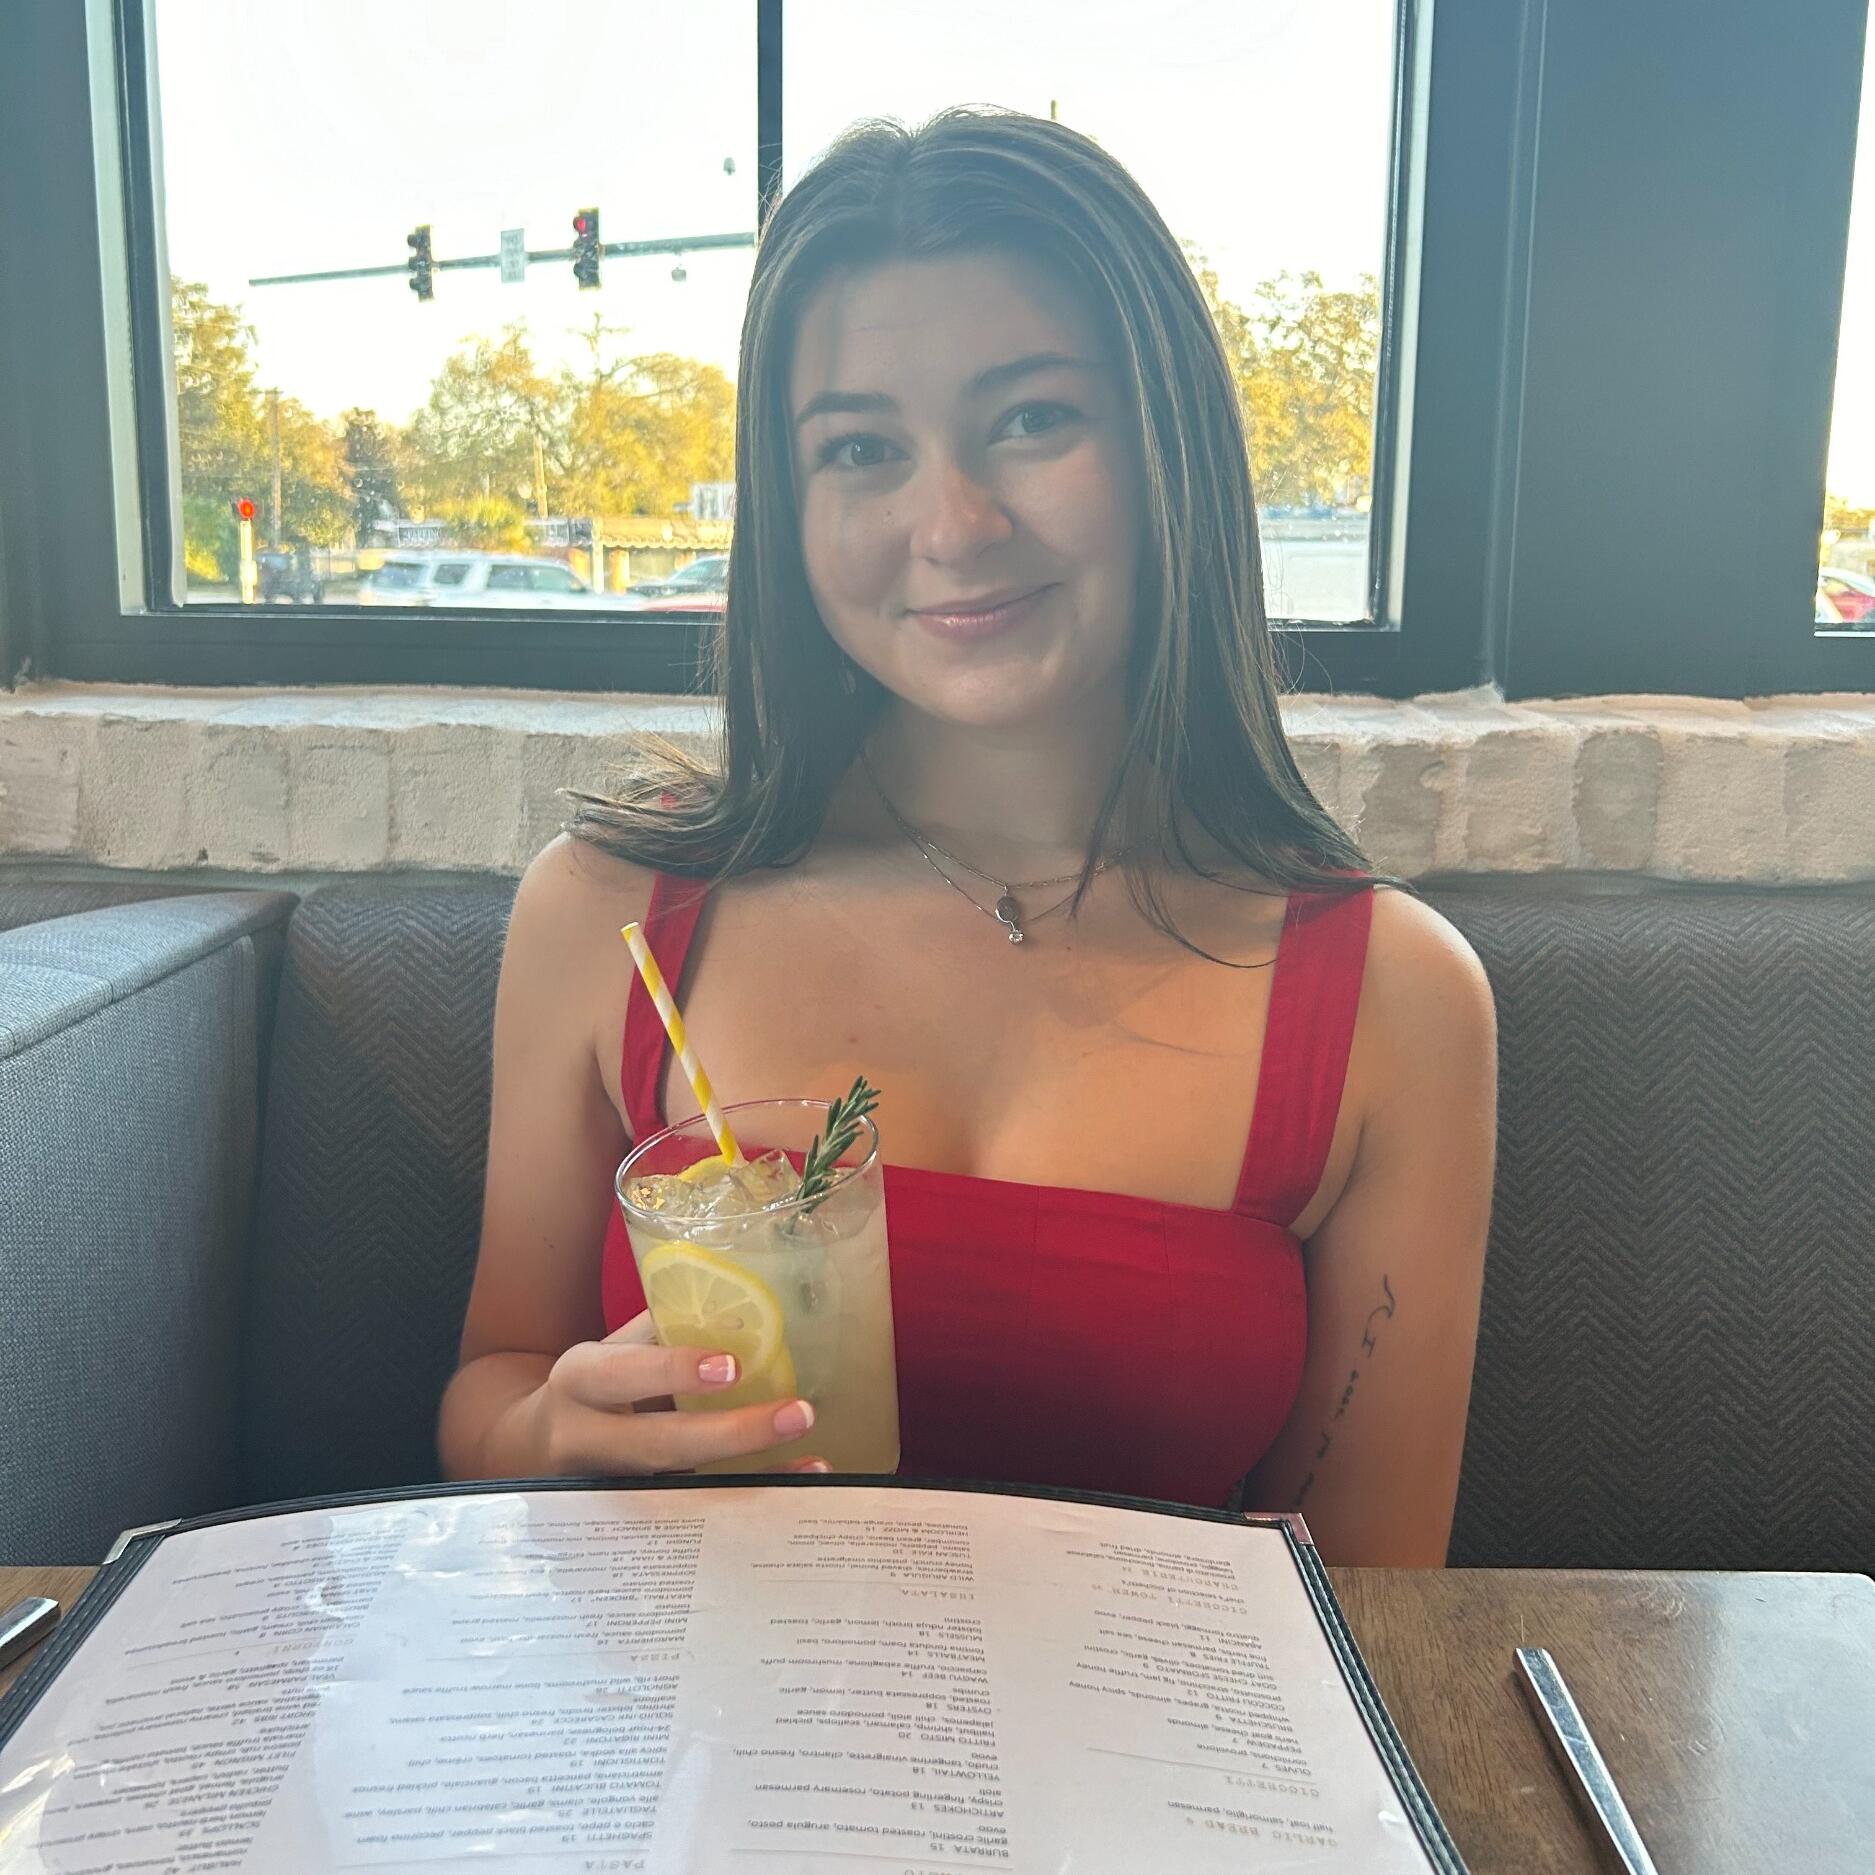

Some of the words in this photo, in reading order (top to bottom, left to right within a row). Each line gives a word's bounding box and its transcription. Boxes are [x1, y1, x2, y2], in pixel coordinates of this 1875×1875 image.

[938, 1632, 982, 1640] MUSSELS
[927, 1652, 984, 1660] MEATBALLS
[1075, 1662, 1106, 1672] honey
[949, 1674, 987, 1682] WAGYU
[1108, 1668, 1138, 1678] truffle
[1068, 1680, 1099, 1691] honey
[1101, 1685, 1126, 1695] spicy
[1206, 1692, 1240, 1703] FRITTO
[947, 1704, 990, 1712] OYSTERS
[829, 1709, 884, 1718] pomodoro
[1167, 1718, 1209, 1729] almonds
[1229, 1716, 1292, 1731] BRUSCHETTA
[920, 1734, 954, 1742] MISTO
[958, 1737, 995, 1745] FRITTO
[910, 1755, 960, 1766] tangerine
[934, 1768, 999, 1779] YELLOWTAIL
[1274, 1764, 1312, 1776] OLIVES
[754, 1782, 810, 1790] parmesan
[813, 1785, 865, 1793] rosemary
[912, 1790, 964, 1802] fingerling
[968, 1796, 1002, 1805] crispy,
[933, 1804, 1003, 1816] ARTICHOKES
[1166, 1799, 1220, 1813] parmesan
[747, 1819, 782, 1827] pesto,
[786, 1820, 829, 1830] arugula
[833, 1823, 878, 1832] tomato,
[586, 1830, 652, 1840] SPAGHETTI
[882, 1827, 925, 1836] roasted
[929, 1830, 973, 1841] crostini,
[561, 1834, 575, 1842] 19
[976, 1834, 1007, 1844] garlic
[929, 1842, 944, 1850] 15
[954, 1844, 1008, 1856] BURRATA
